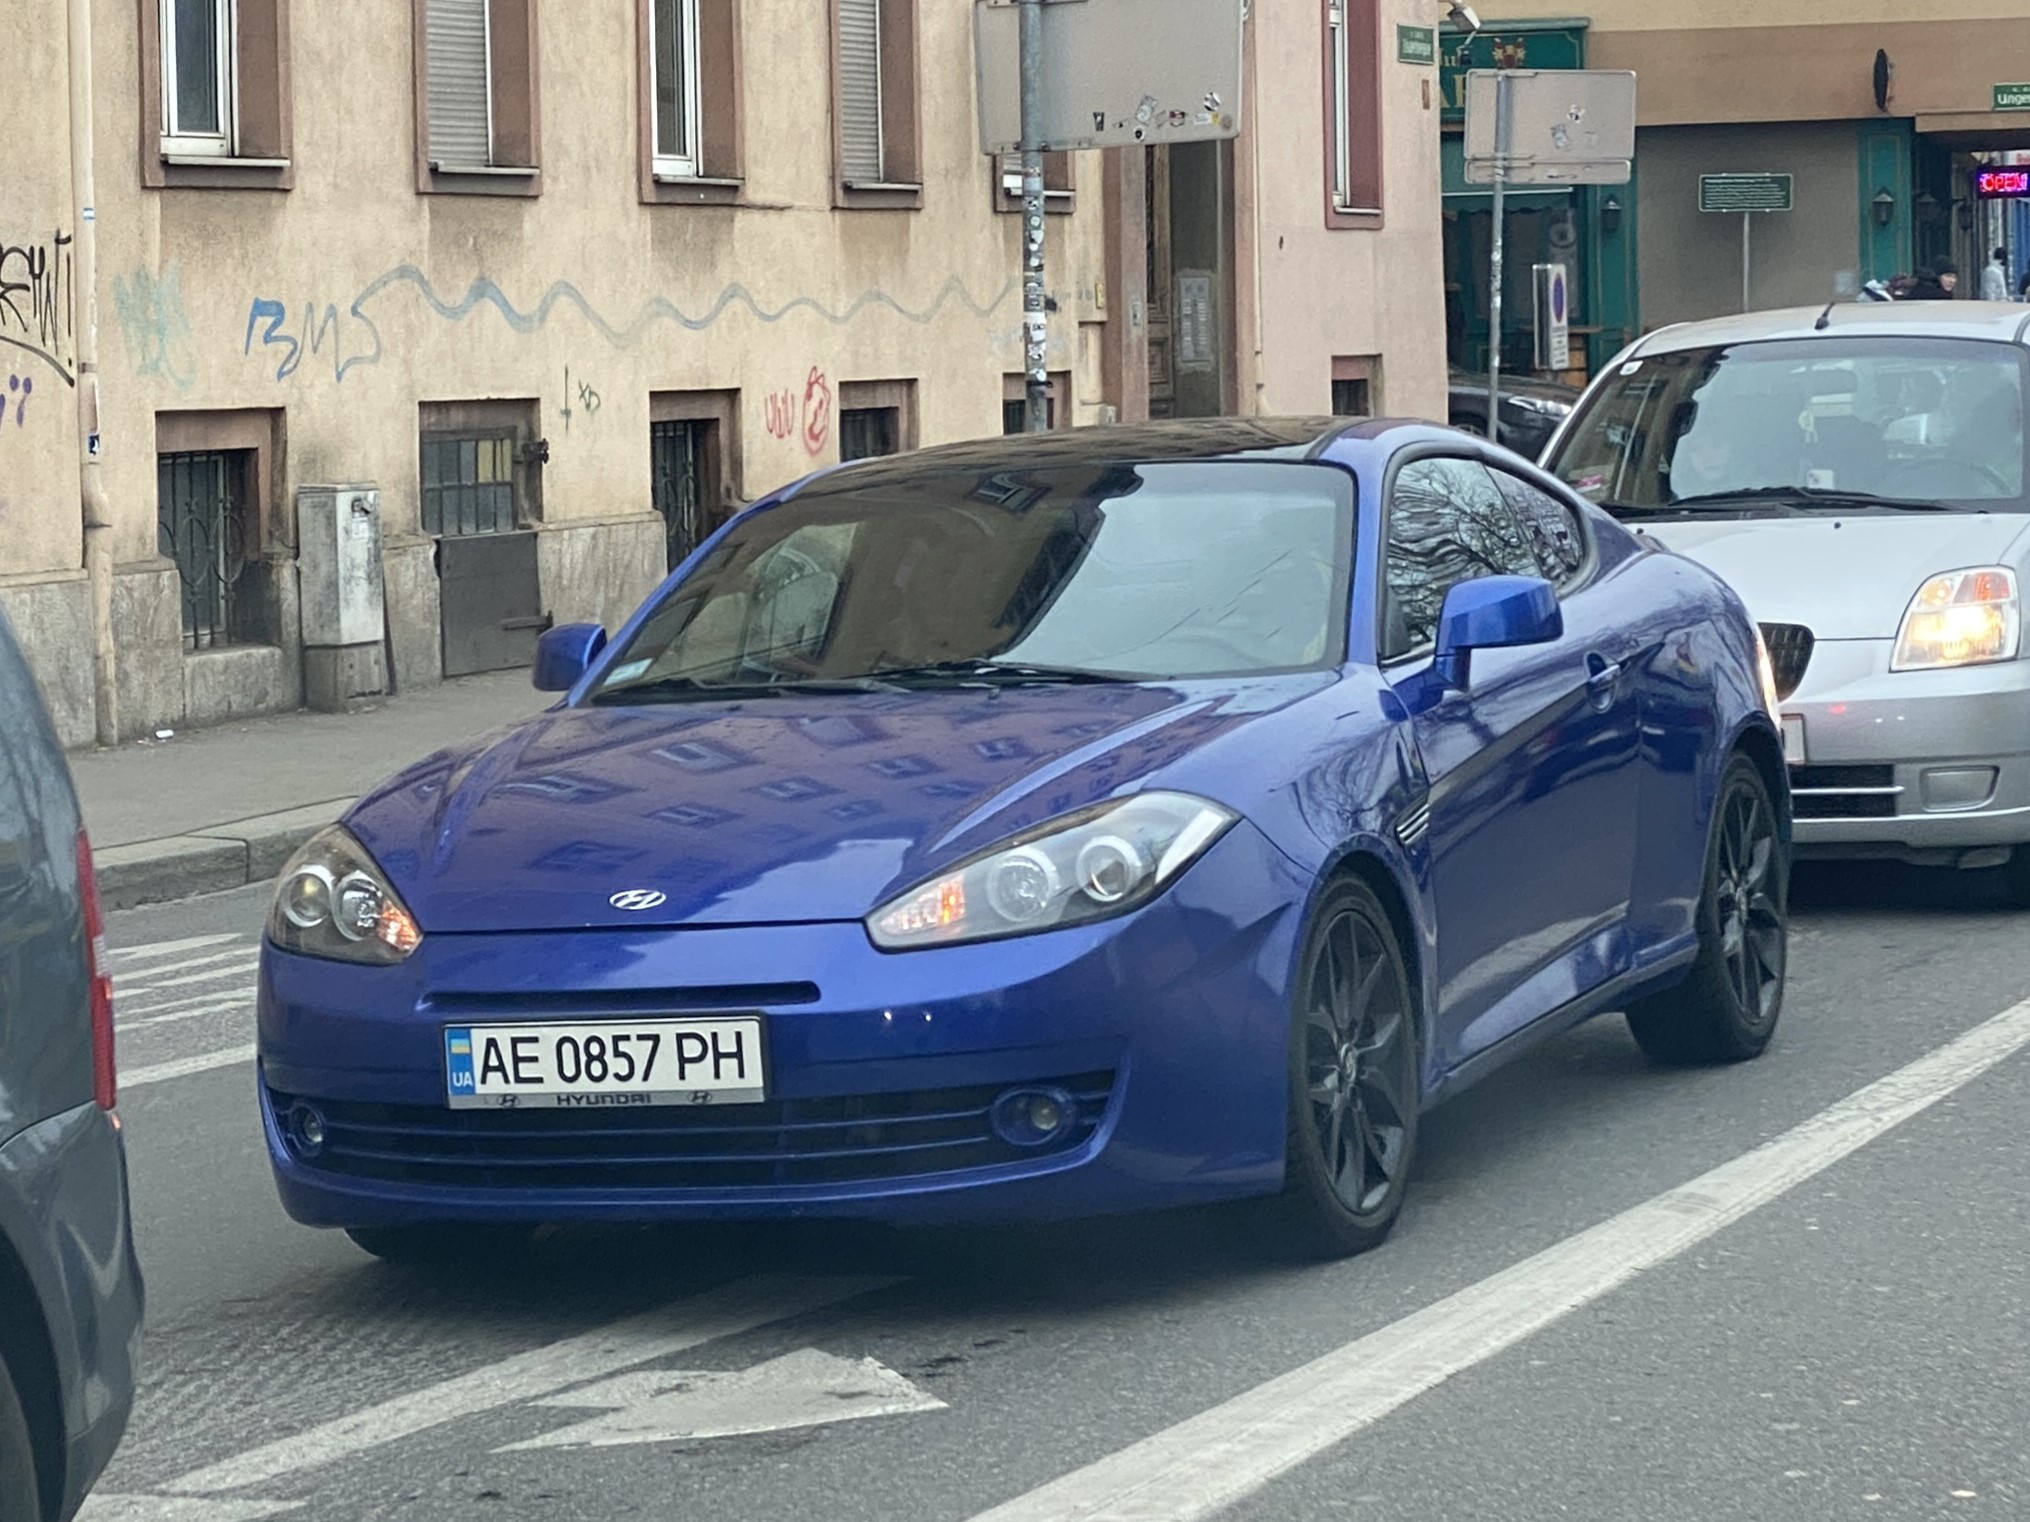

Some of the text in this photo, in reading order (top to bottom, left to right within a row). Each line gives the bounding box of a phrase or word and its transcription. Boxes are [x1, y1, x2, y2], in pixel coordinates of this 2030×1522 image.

[1981, 174, 2026, 191] OPEN
[480, 1031, 745, 1085] AE 0857 PH
[452, 1072, 473, 1087] UA
[557, 1093, 652, 1106] HYUNDAI
